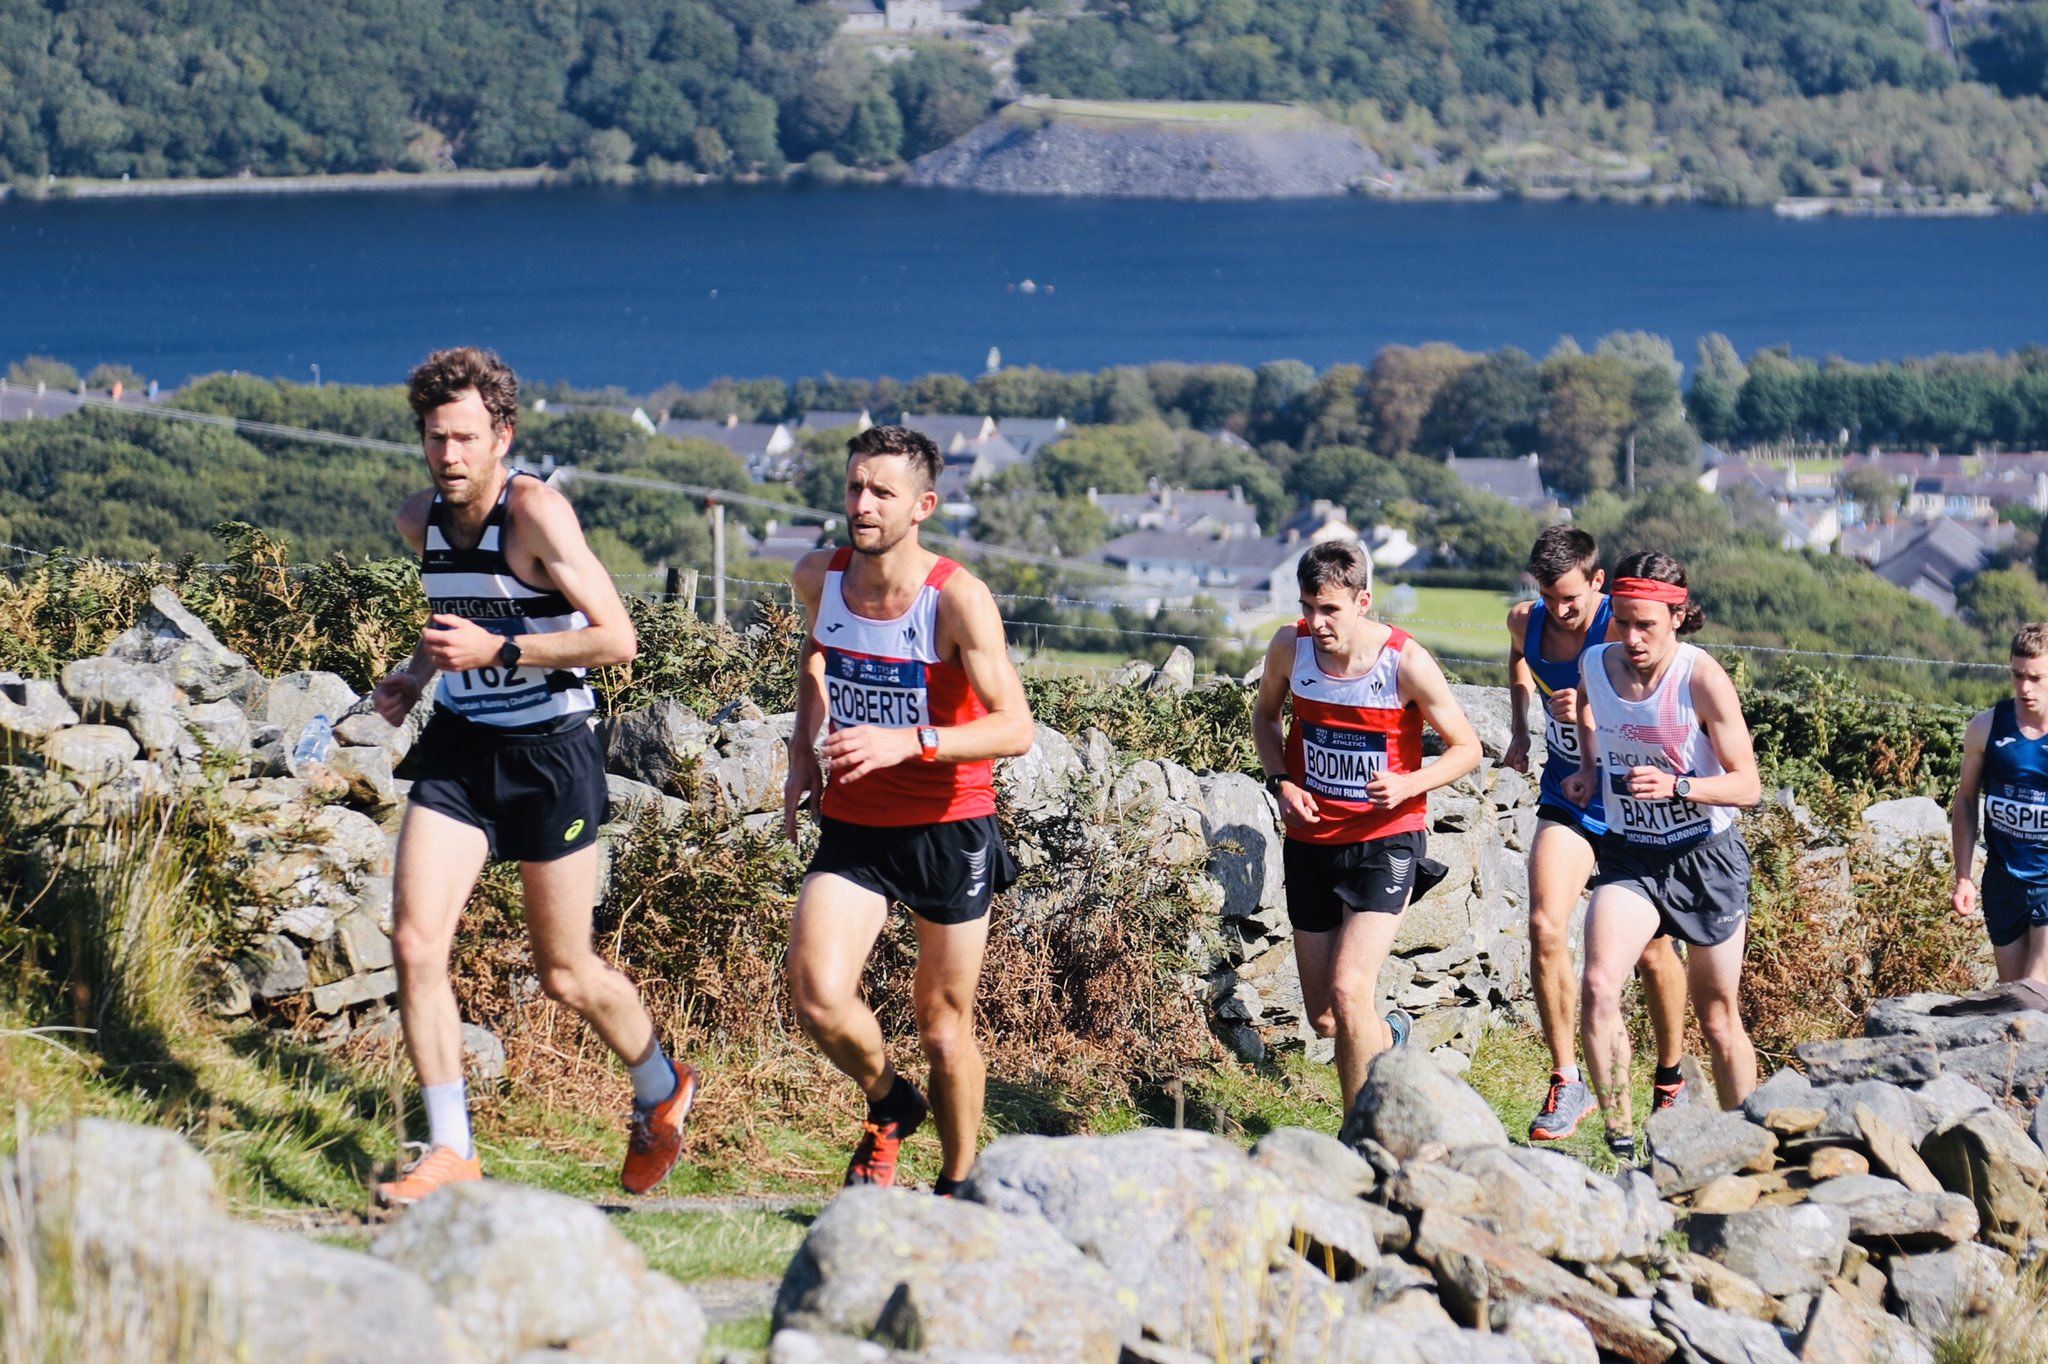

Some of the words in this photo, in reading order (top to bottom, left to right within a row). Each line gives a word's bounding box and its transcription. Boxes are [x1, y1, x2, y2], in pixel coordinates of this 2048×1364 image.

[860, 674, 900, 682] ATHLETICS
[861, 664, 899, 674] BRITISH
[828, 681, 920, 725] ROBERTS
[1332, 732, 1366, 742] BRITISH
[1332, 738, 1367, 747] ATHLETICS
[1307, 745, 1379, 781] BODMAN
[1608, 751, 1670, 769] ENGLAN
[1305, 776, 1342, 797] MOUNTAIN
[1343, 788, 1369, 799] RUNN
[1620, 799, 1702, 829] BAXTER
[1626, 832, 1667, 845] MOUNTAIN
[1667, 823, 1710, 844] RUNNING
